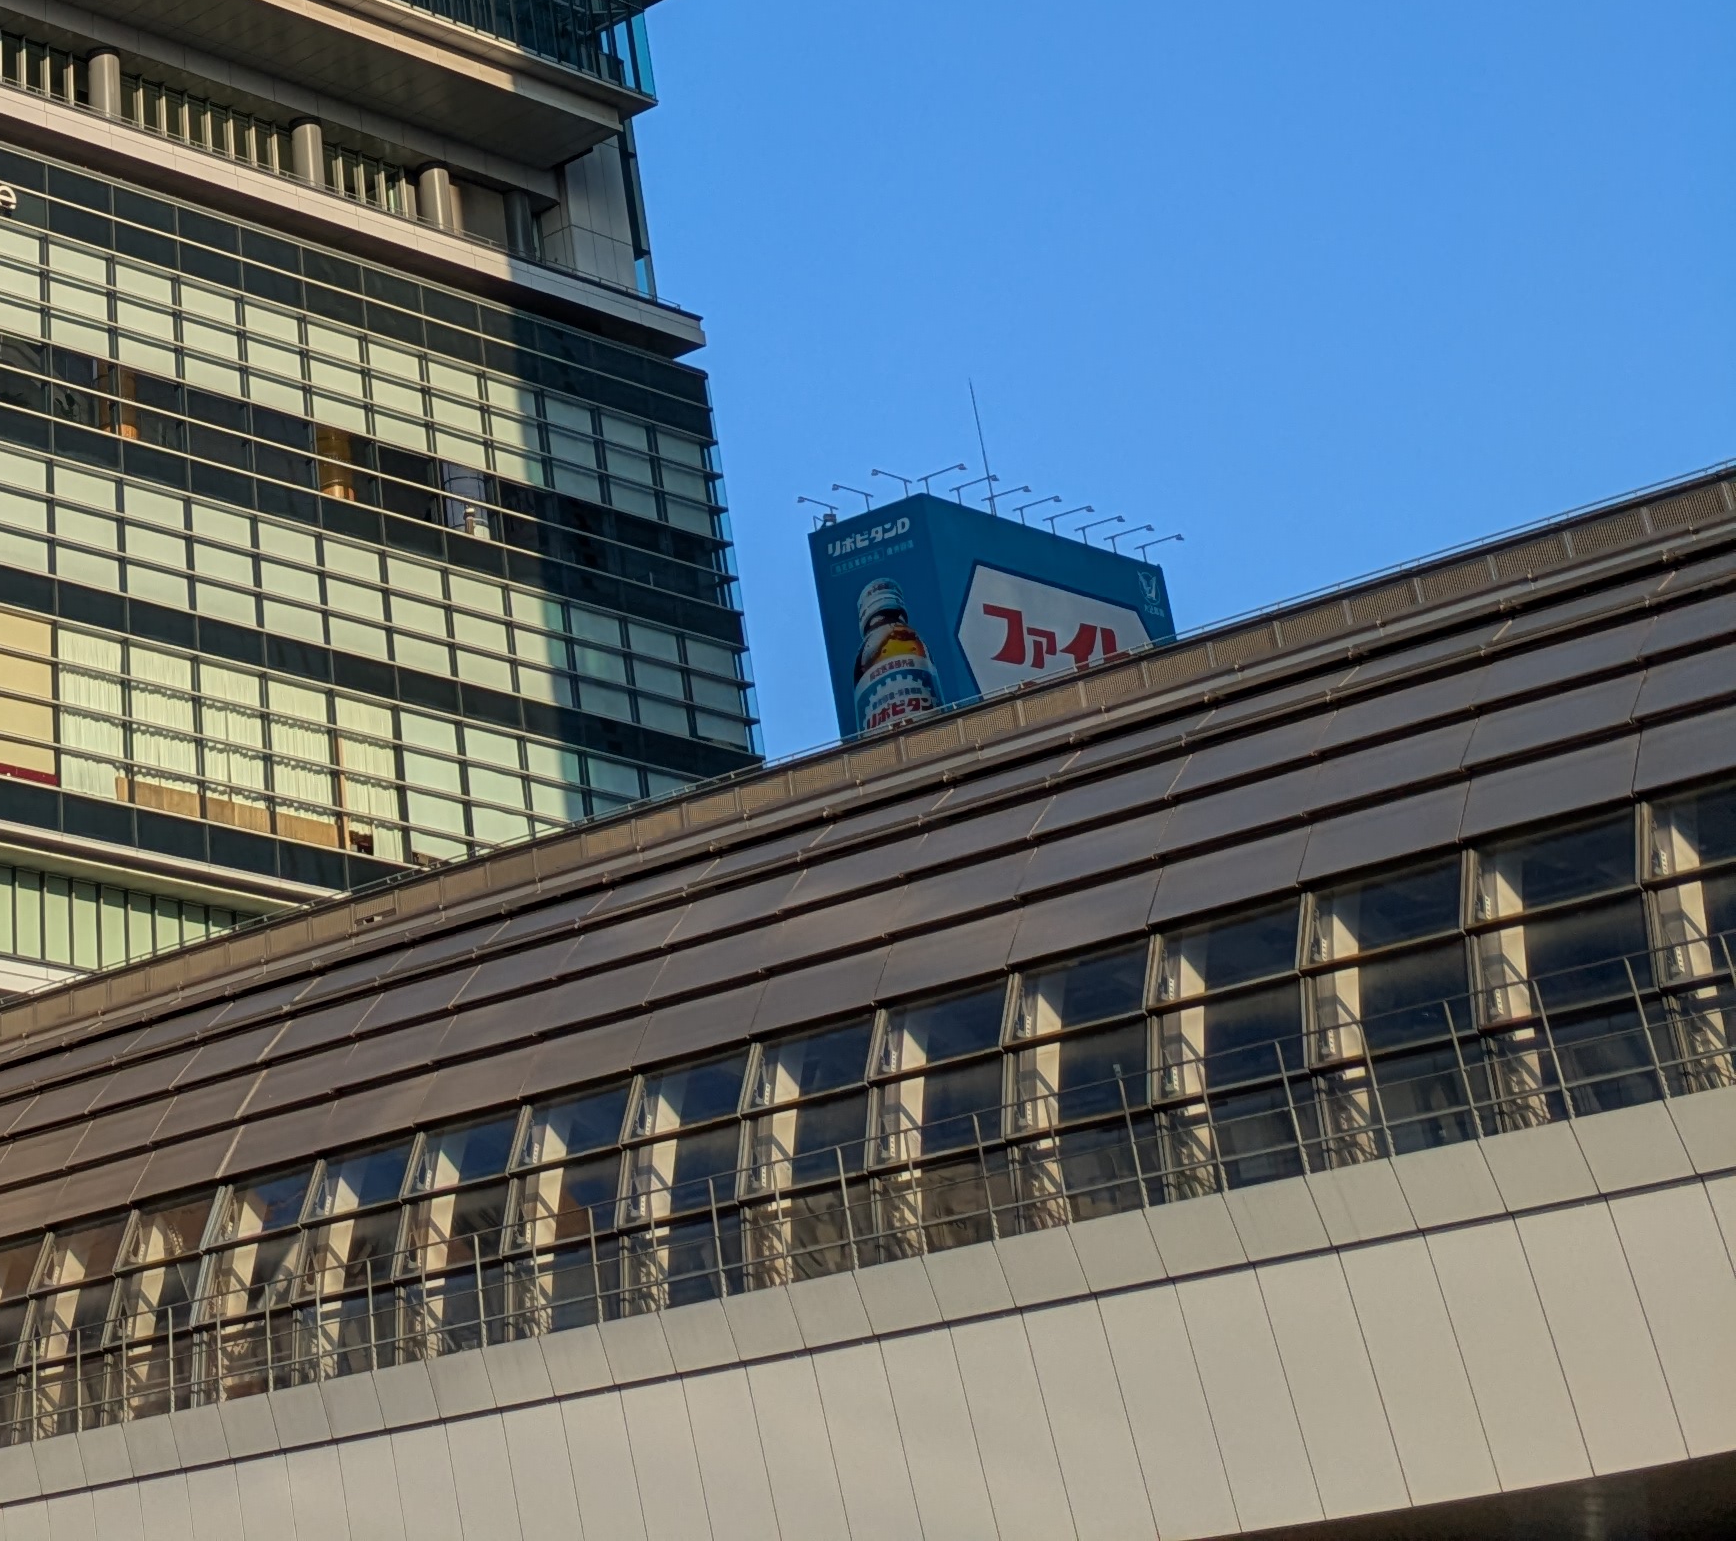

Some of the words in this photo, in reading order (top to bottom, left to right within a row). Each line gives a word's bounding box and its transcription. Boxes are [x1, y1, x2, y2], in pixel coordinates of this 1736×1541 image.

[827, 516, 910, 557] リポビタンD
